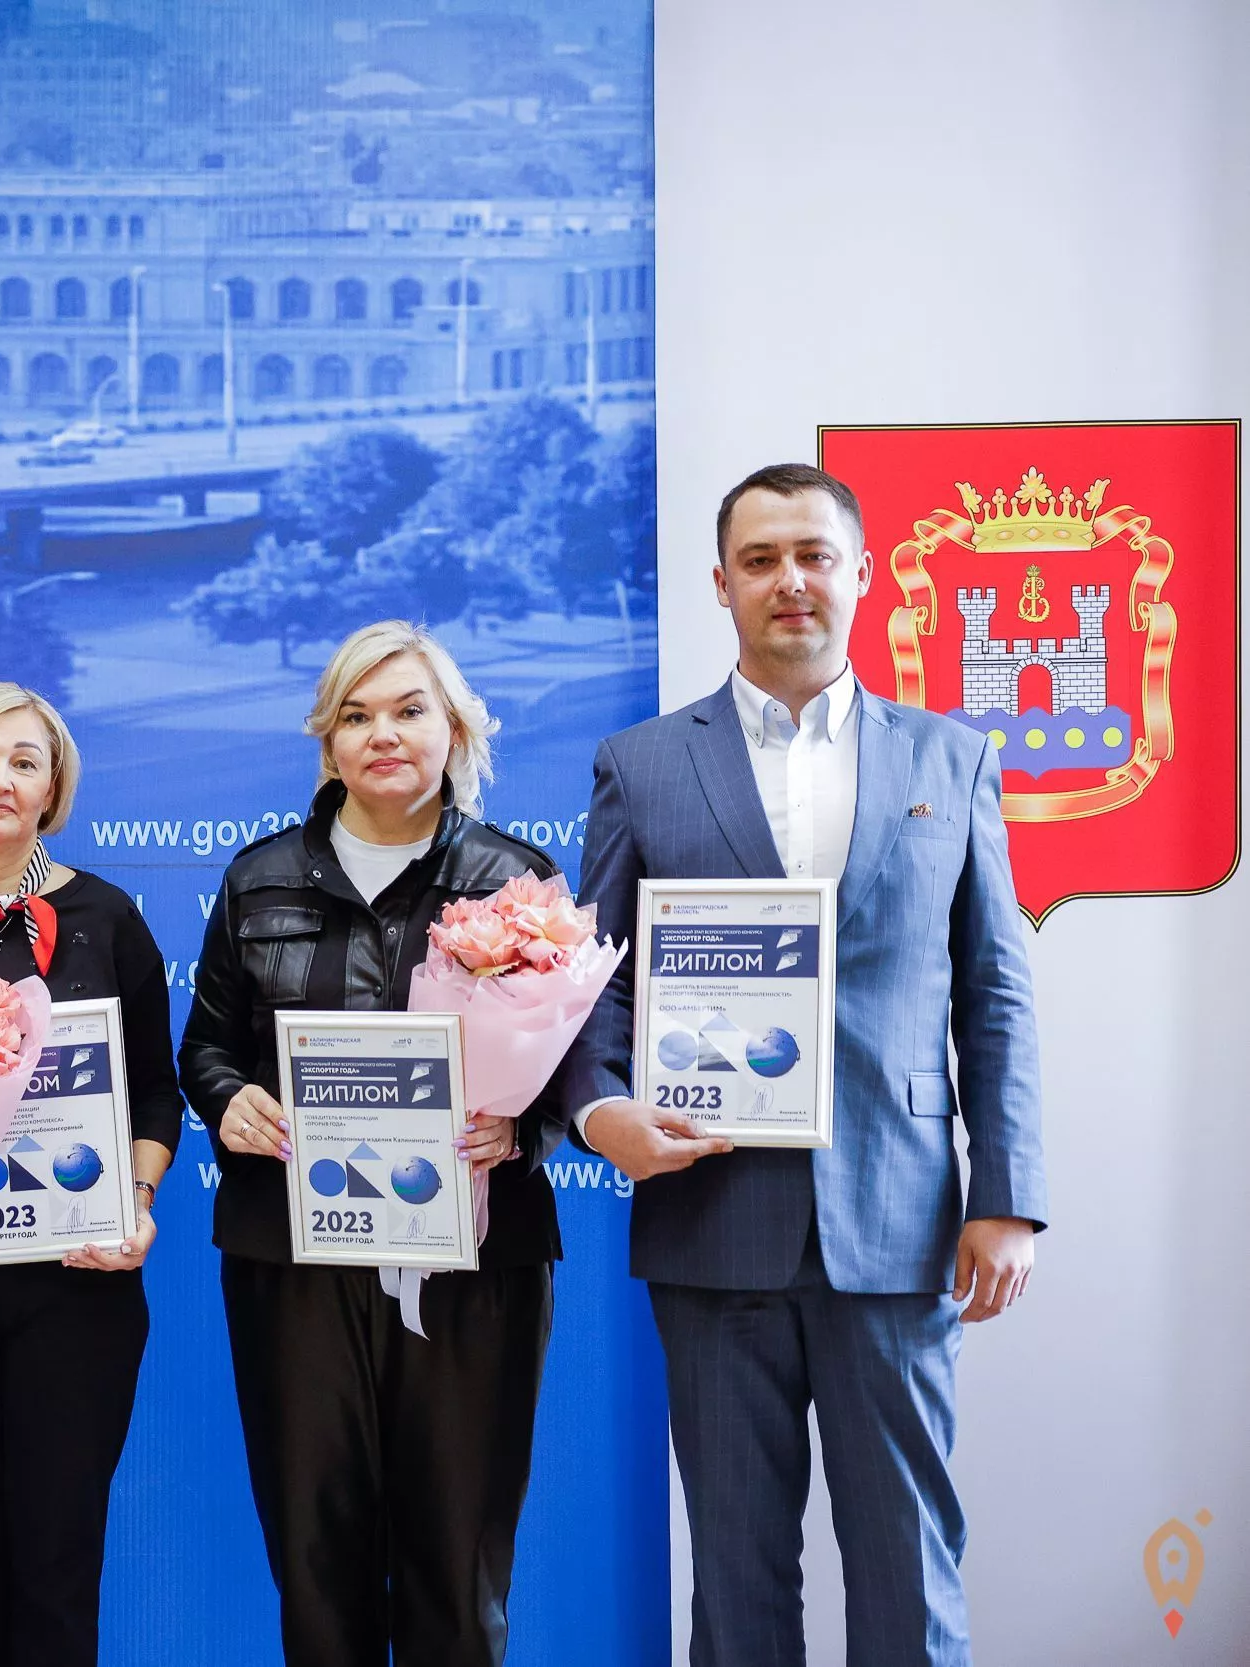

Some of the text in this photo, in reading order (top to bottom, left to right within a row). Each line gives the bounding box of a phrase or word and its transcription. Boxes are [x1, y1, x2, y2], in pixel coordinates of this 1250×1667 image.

[660, 934, 702, 942] «ЭКСПОРТЕР
[659, 953, 763, 973] ДИПЛОМ
[300, 1066, 339, 1074] «ЭКСПОРТЕР
[302, 1084, 399, 1104] ДИПЛОМ
[656, 1084, 722, 1109] 2023
[701, 1113, 722, 1121] ГОДА
[311, 1210, 374, 1234] 2023
[17, 1231, 38, 1239] ГОДА
[312, 1235, 375, 1245] ЭКСПОРТЕР ГОДА
